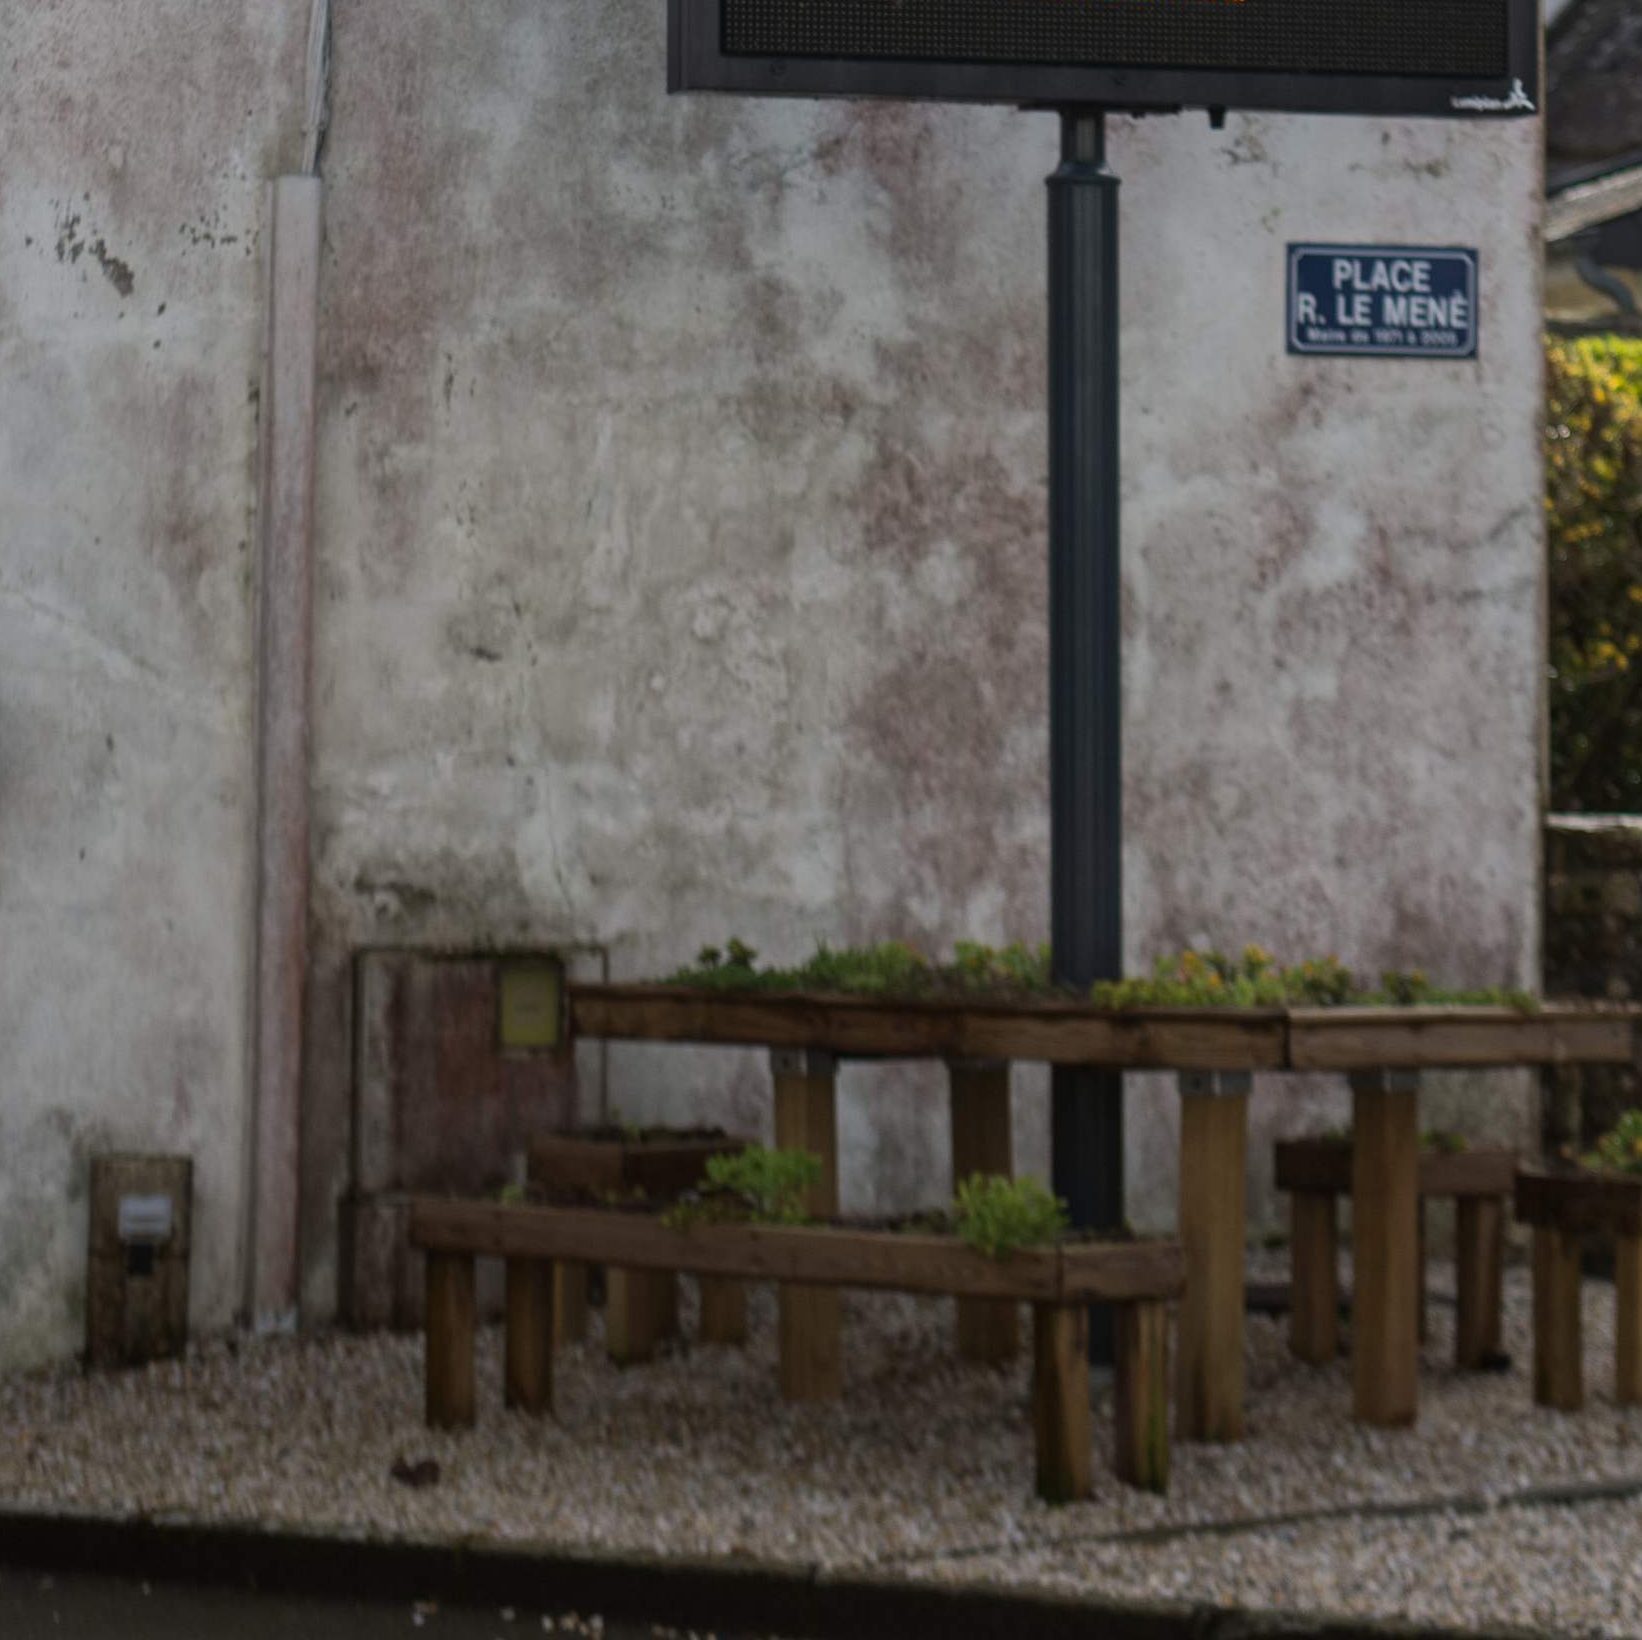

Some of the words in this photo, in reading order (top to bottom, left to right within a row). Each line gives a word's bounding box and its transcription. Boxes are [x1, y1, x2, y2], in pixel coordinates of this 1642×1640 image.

[1332, 258, 1432, 292] PLACE
[1297, 292, 1326, 325] R.
[1336, 294, 1372, 326] LE
